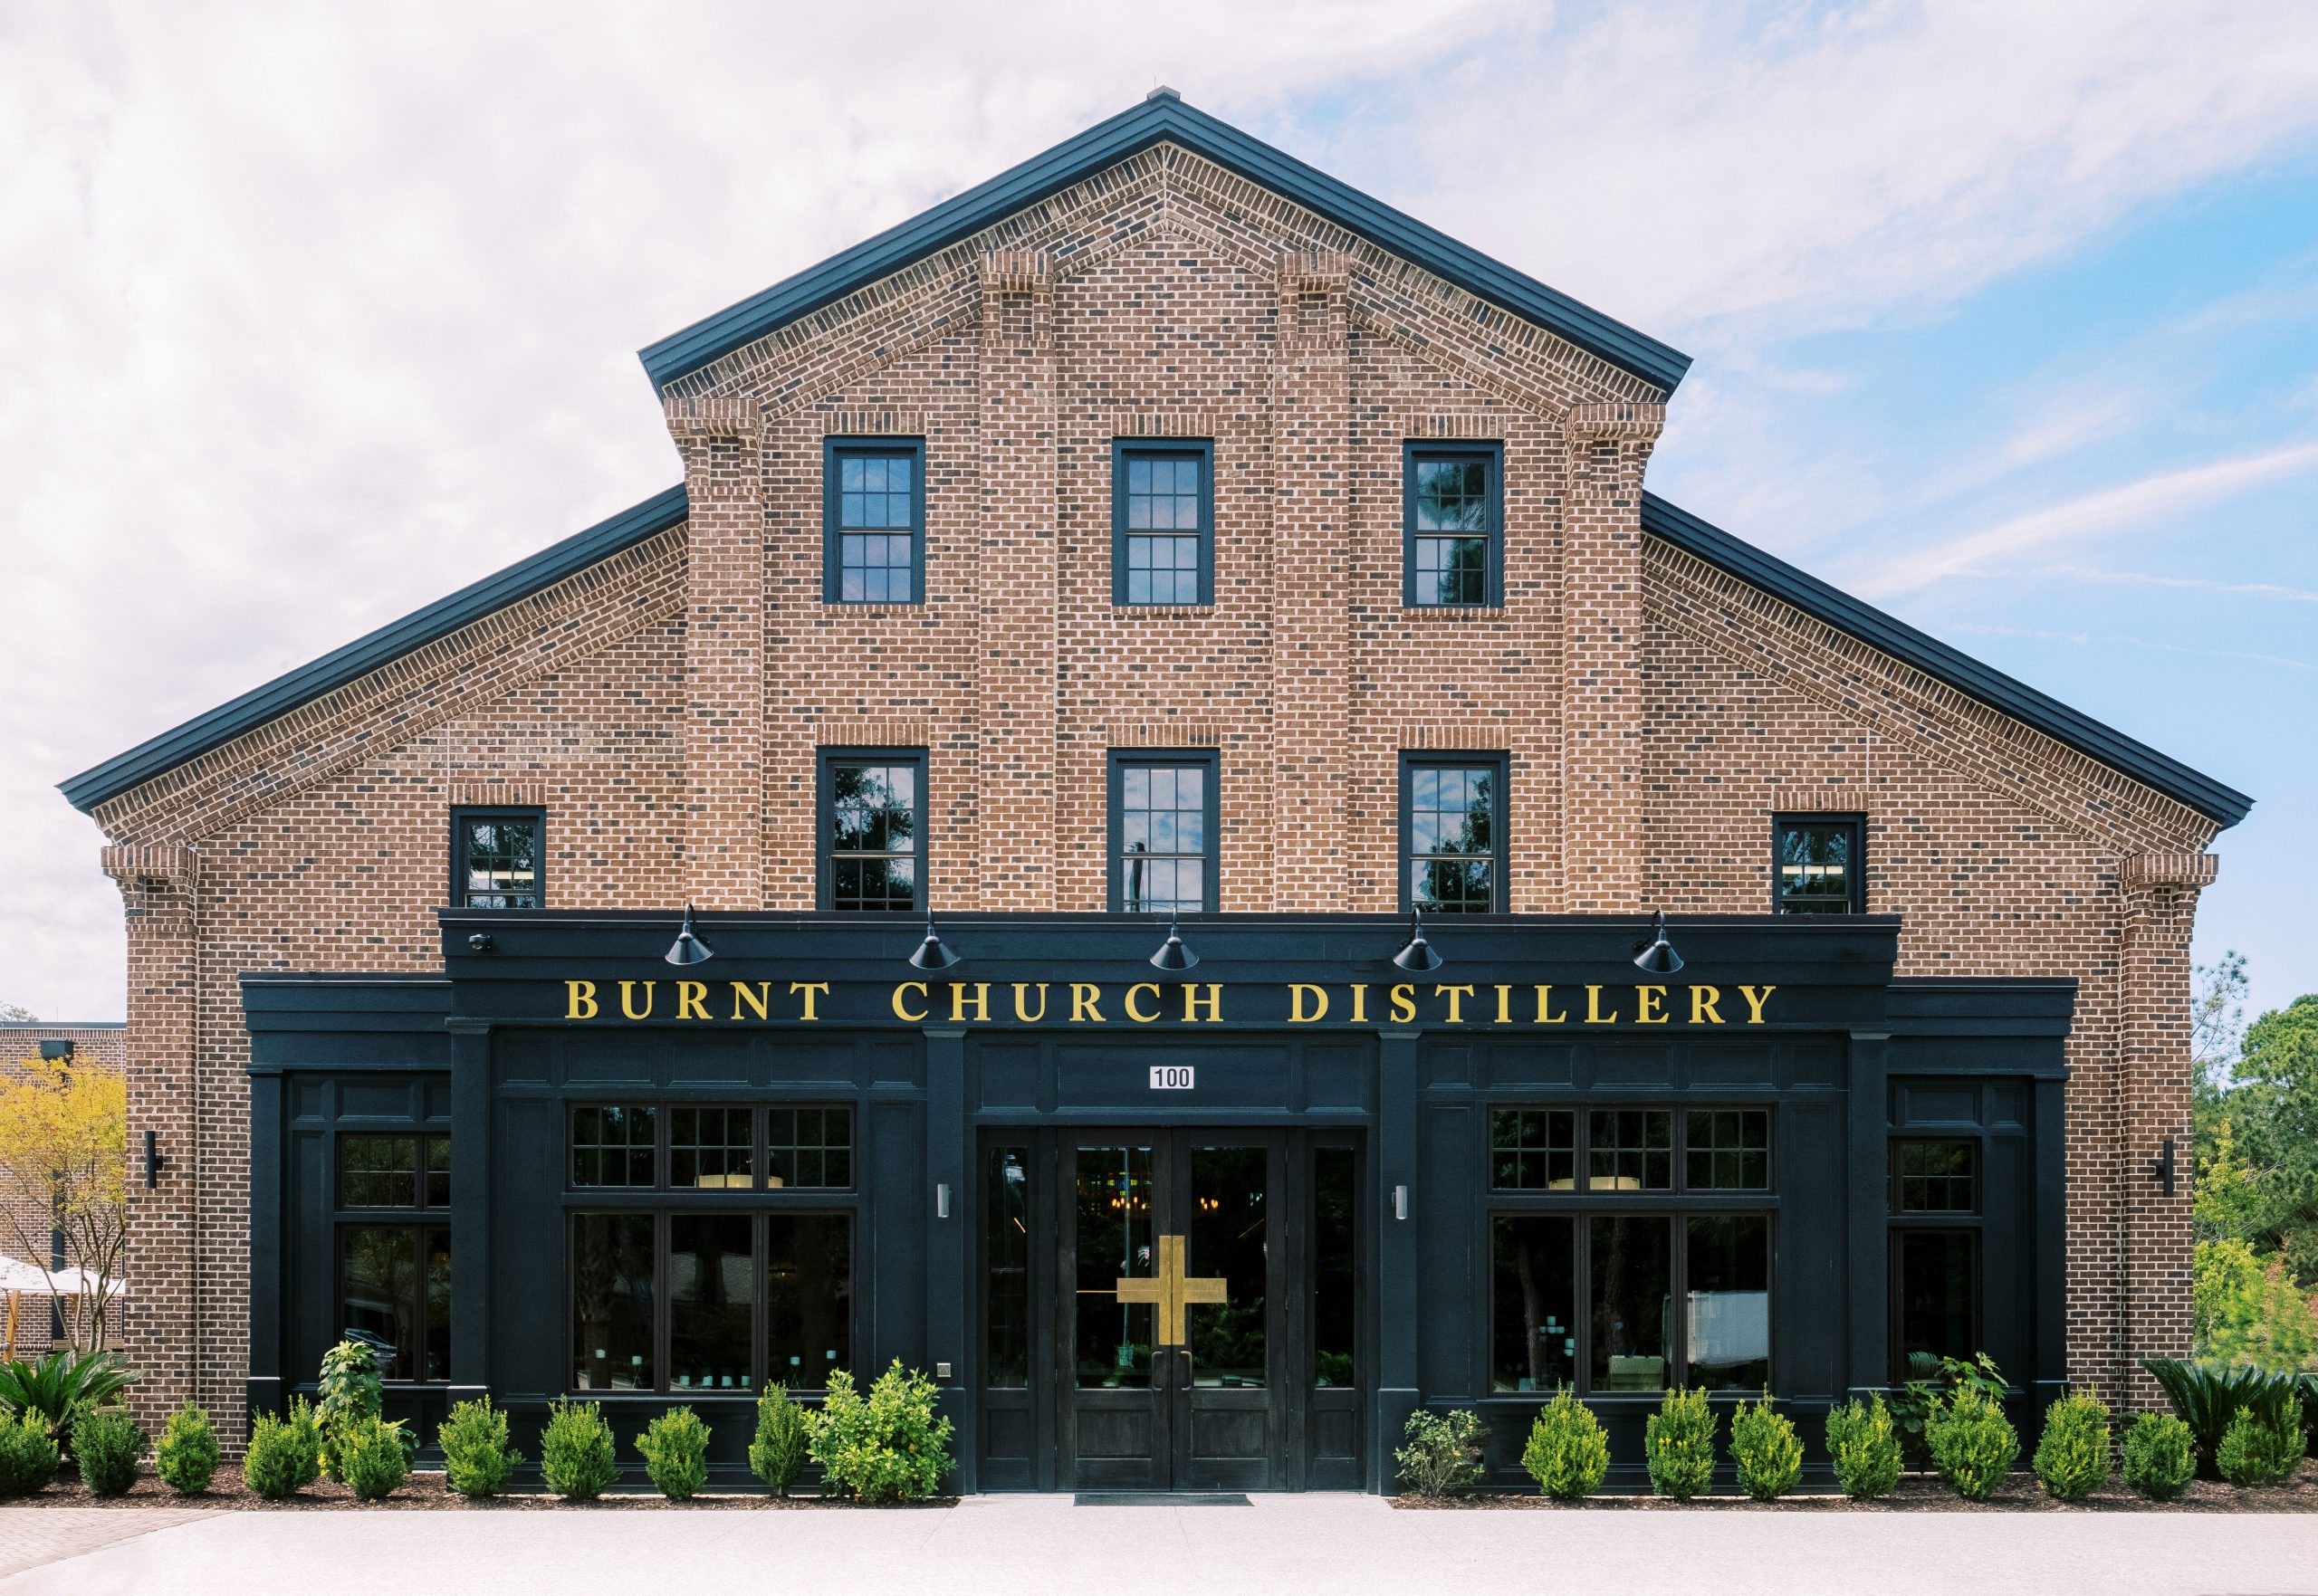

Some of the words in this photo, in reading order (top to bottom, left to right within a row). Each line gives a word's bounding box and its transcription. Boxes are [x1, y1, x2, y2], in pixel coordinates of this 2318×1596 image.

[564, 980, 829, 1021] BURNT
[891, 981, 1224, 1022] CHURCH
[1288, 984, 1777, 1024] DISTILLERY
[1154, 1068, 1190, 1087] 100
